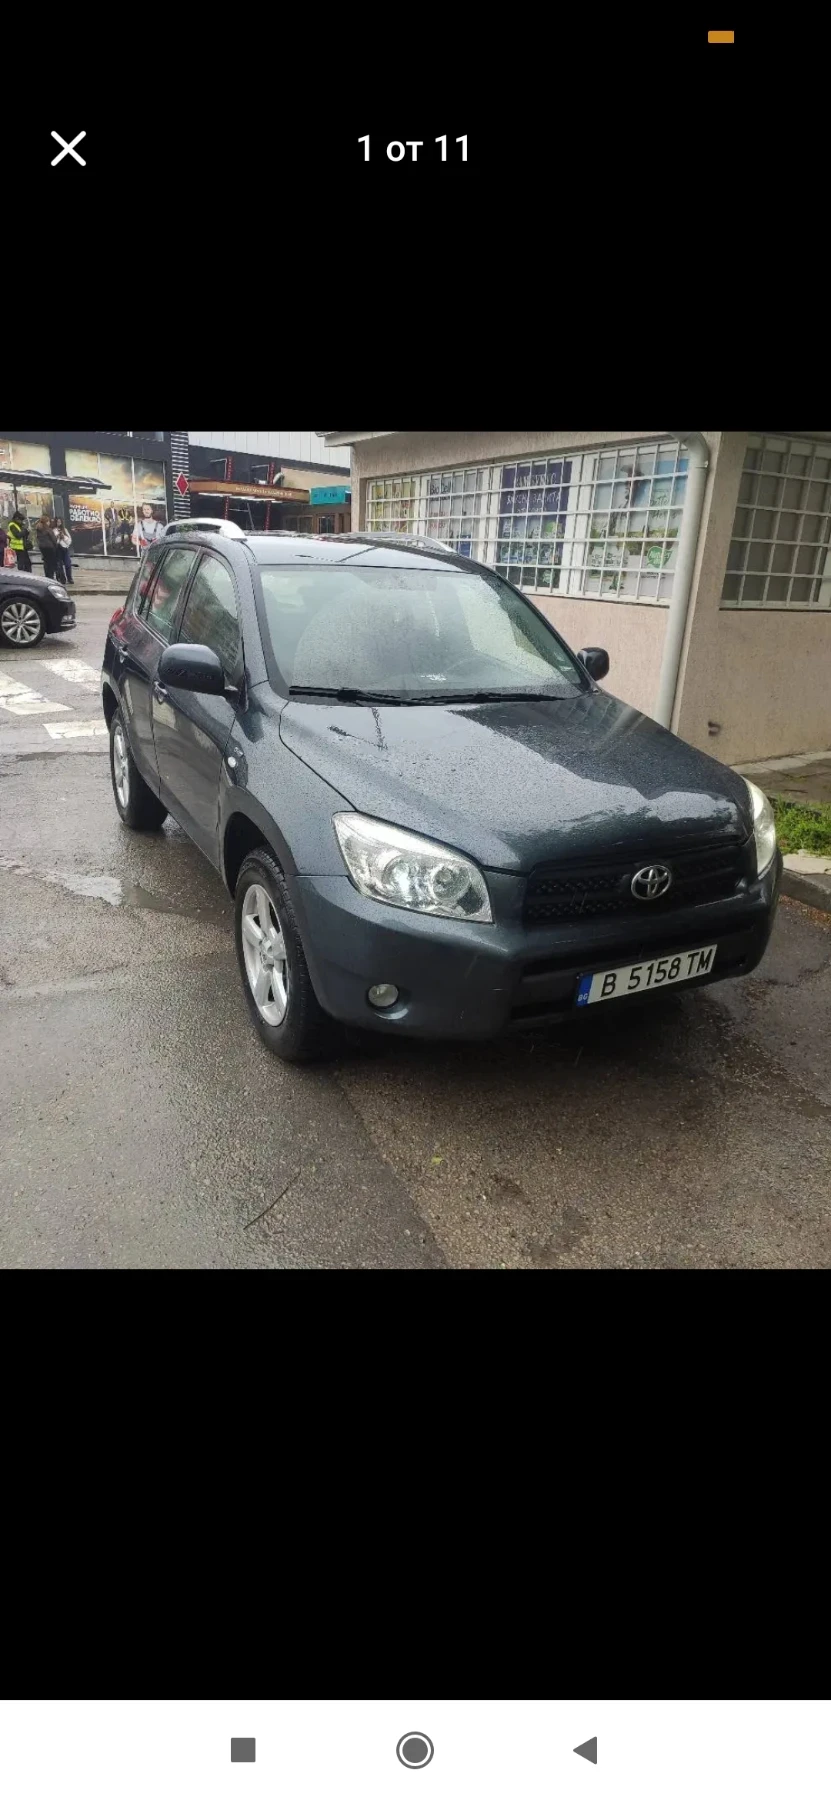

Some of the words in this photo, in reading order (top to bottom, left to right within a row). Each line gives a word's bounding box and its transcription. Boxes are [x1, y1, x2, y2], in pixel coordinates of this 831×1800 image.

[600, 972, 617, 998] B
[627, 957, 682, 990] 5158
[687, 949, 713, 975] TM
[577, 993, 589, 1002] BG
